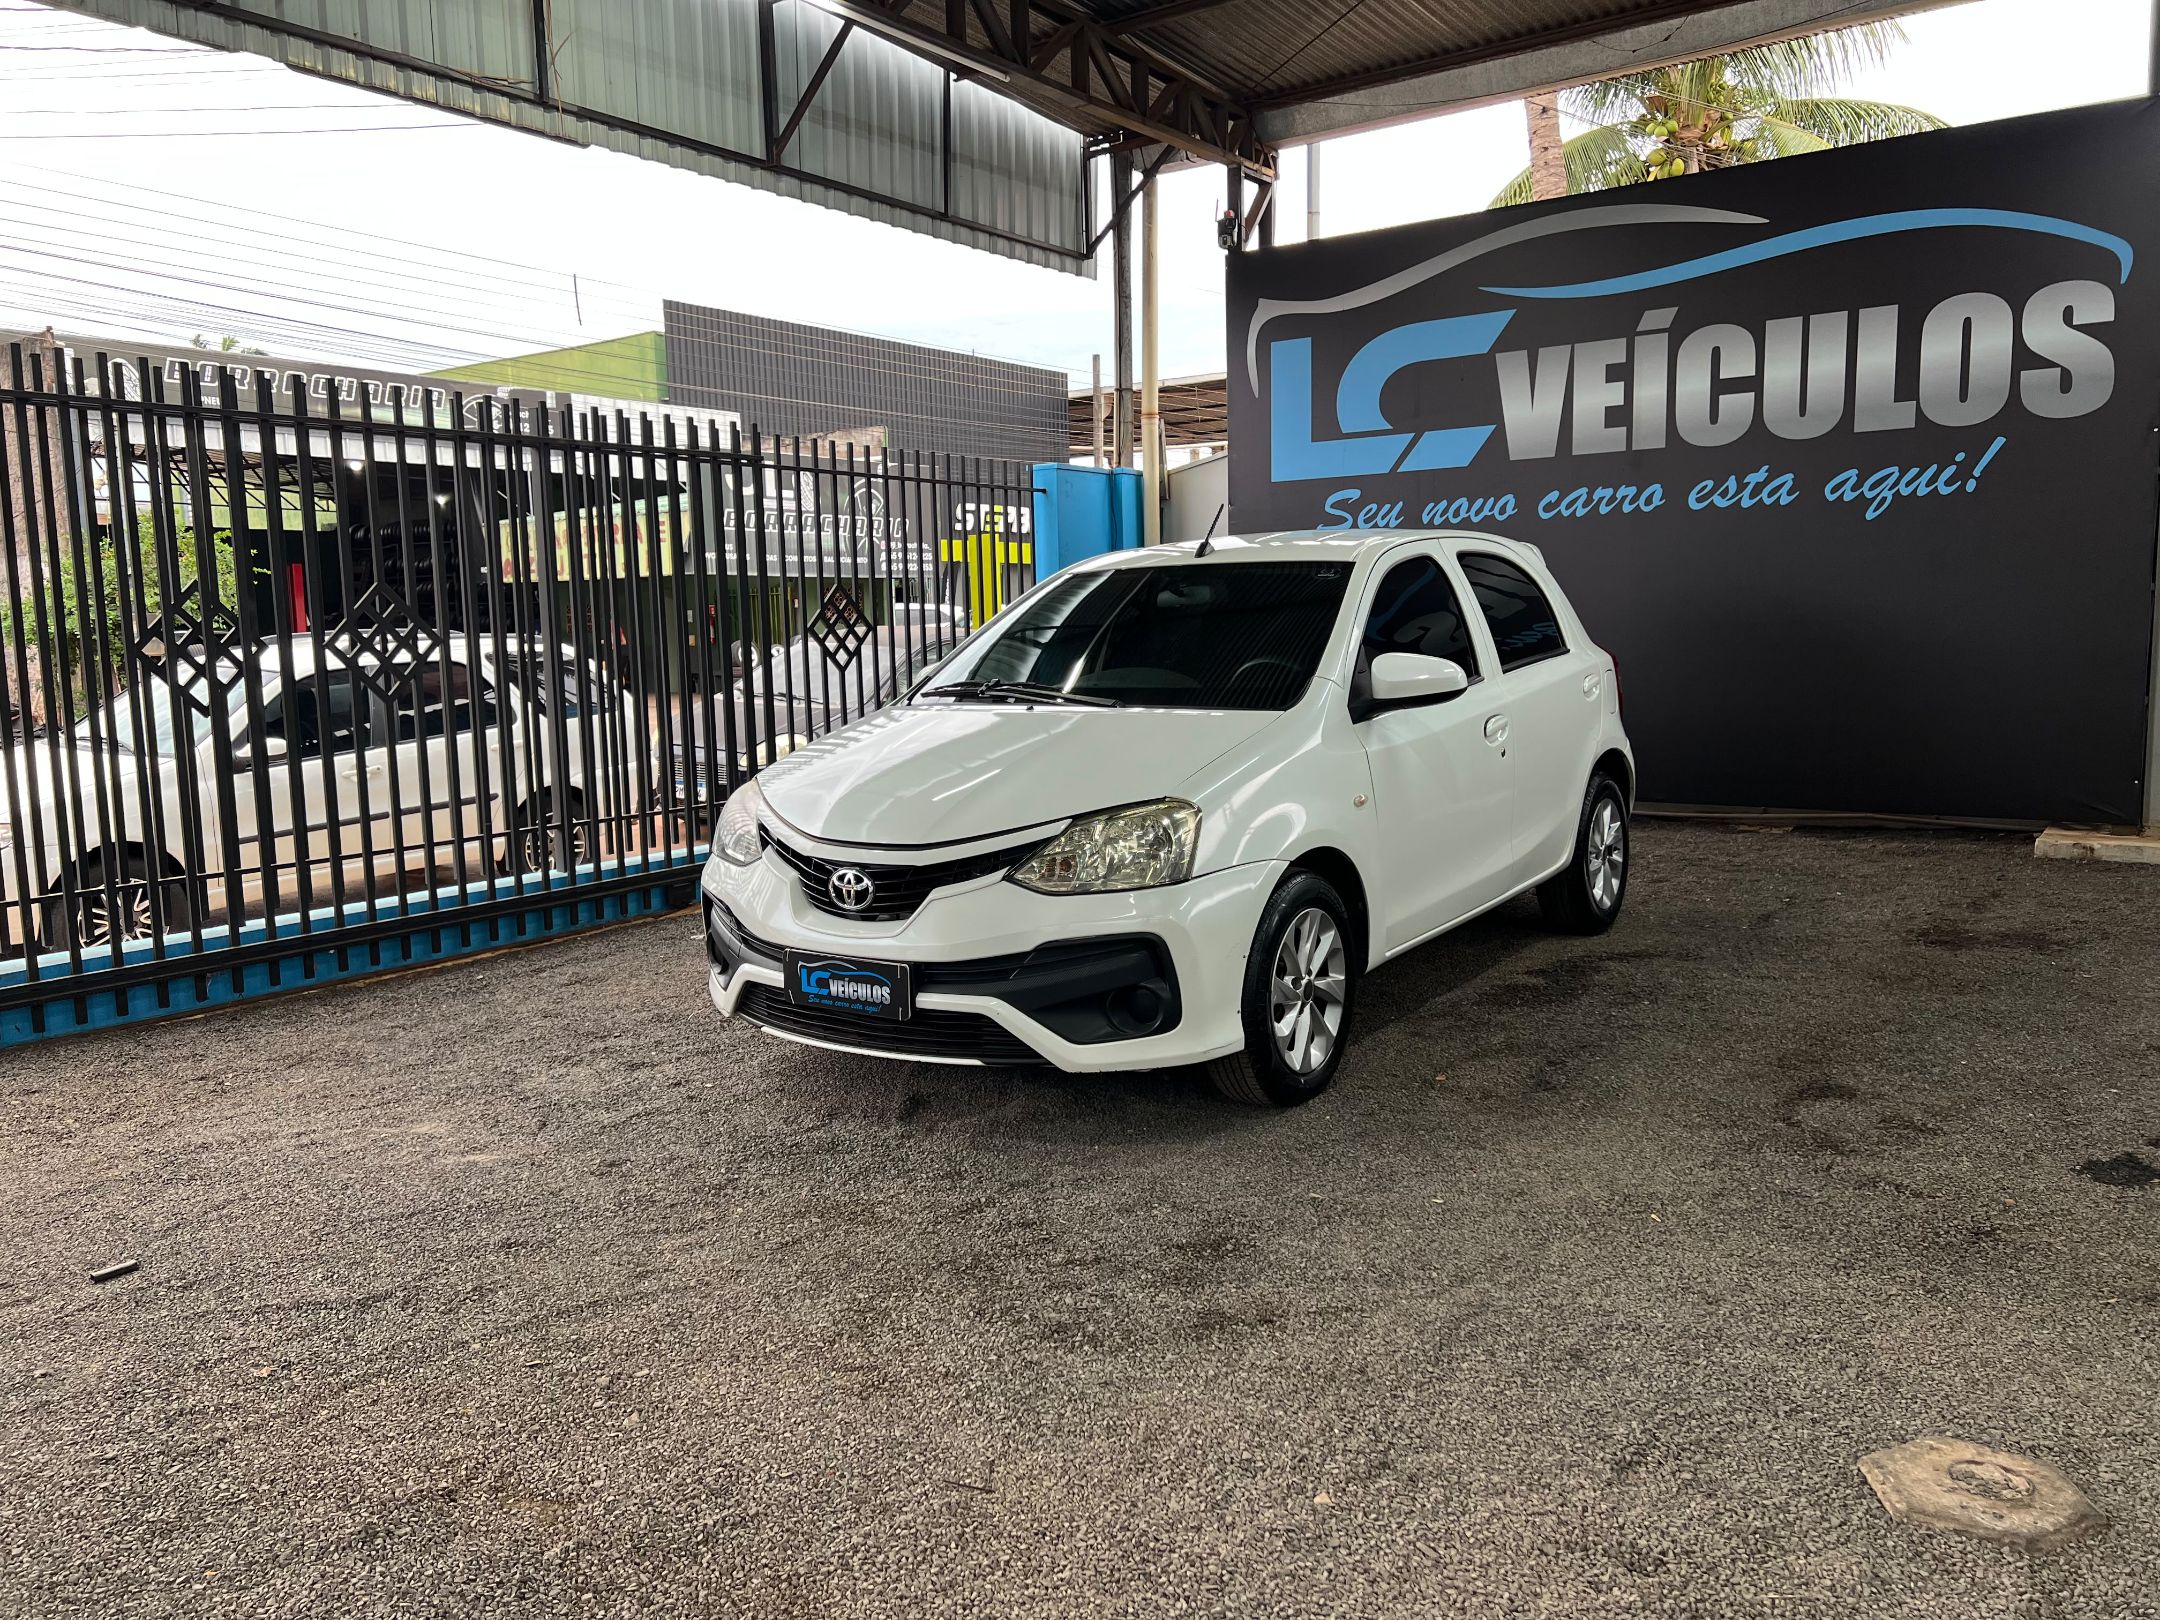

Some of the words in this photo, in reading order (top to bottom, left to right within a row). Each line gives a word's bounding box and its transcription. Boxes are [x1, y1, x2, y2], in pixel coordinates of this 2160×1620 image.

[1271, 309, 1517, 482] LC
[1494, 279, 2117, 461] VEÍCULOS
[1316, 488, 1404, 530] Seu
[1421, 493, 1518, 526] novo
[1537, 483, 1666, 520] carro
[1688, 464, 1801, 511] esta
[1823, 436, 2007, 521] aqui!
[800, 967, 832, 995] LC
[828, 977, 891, 1005] VEÍCULOS
